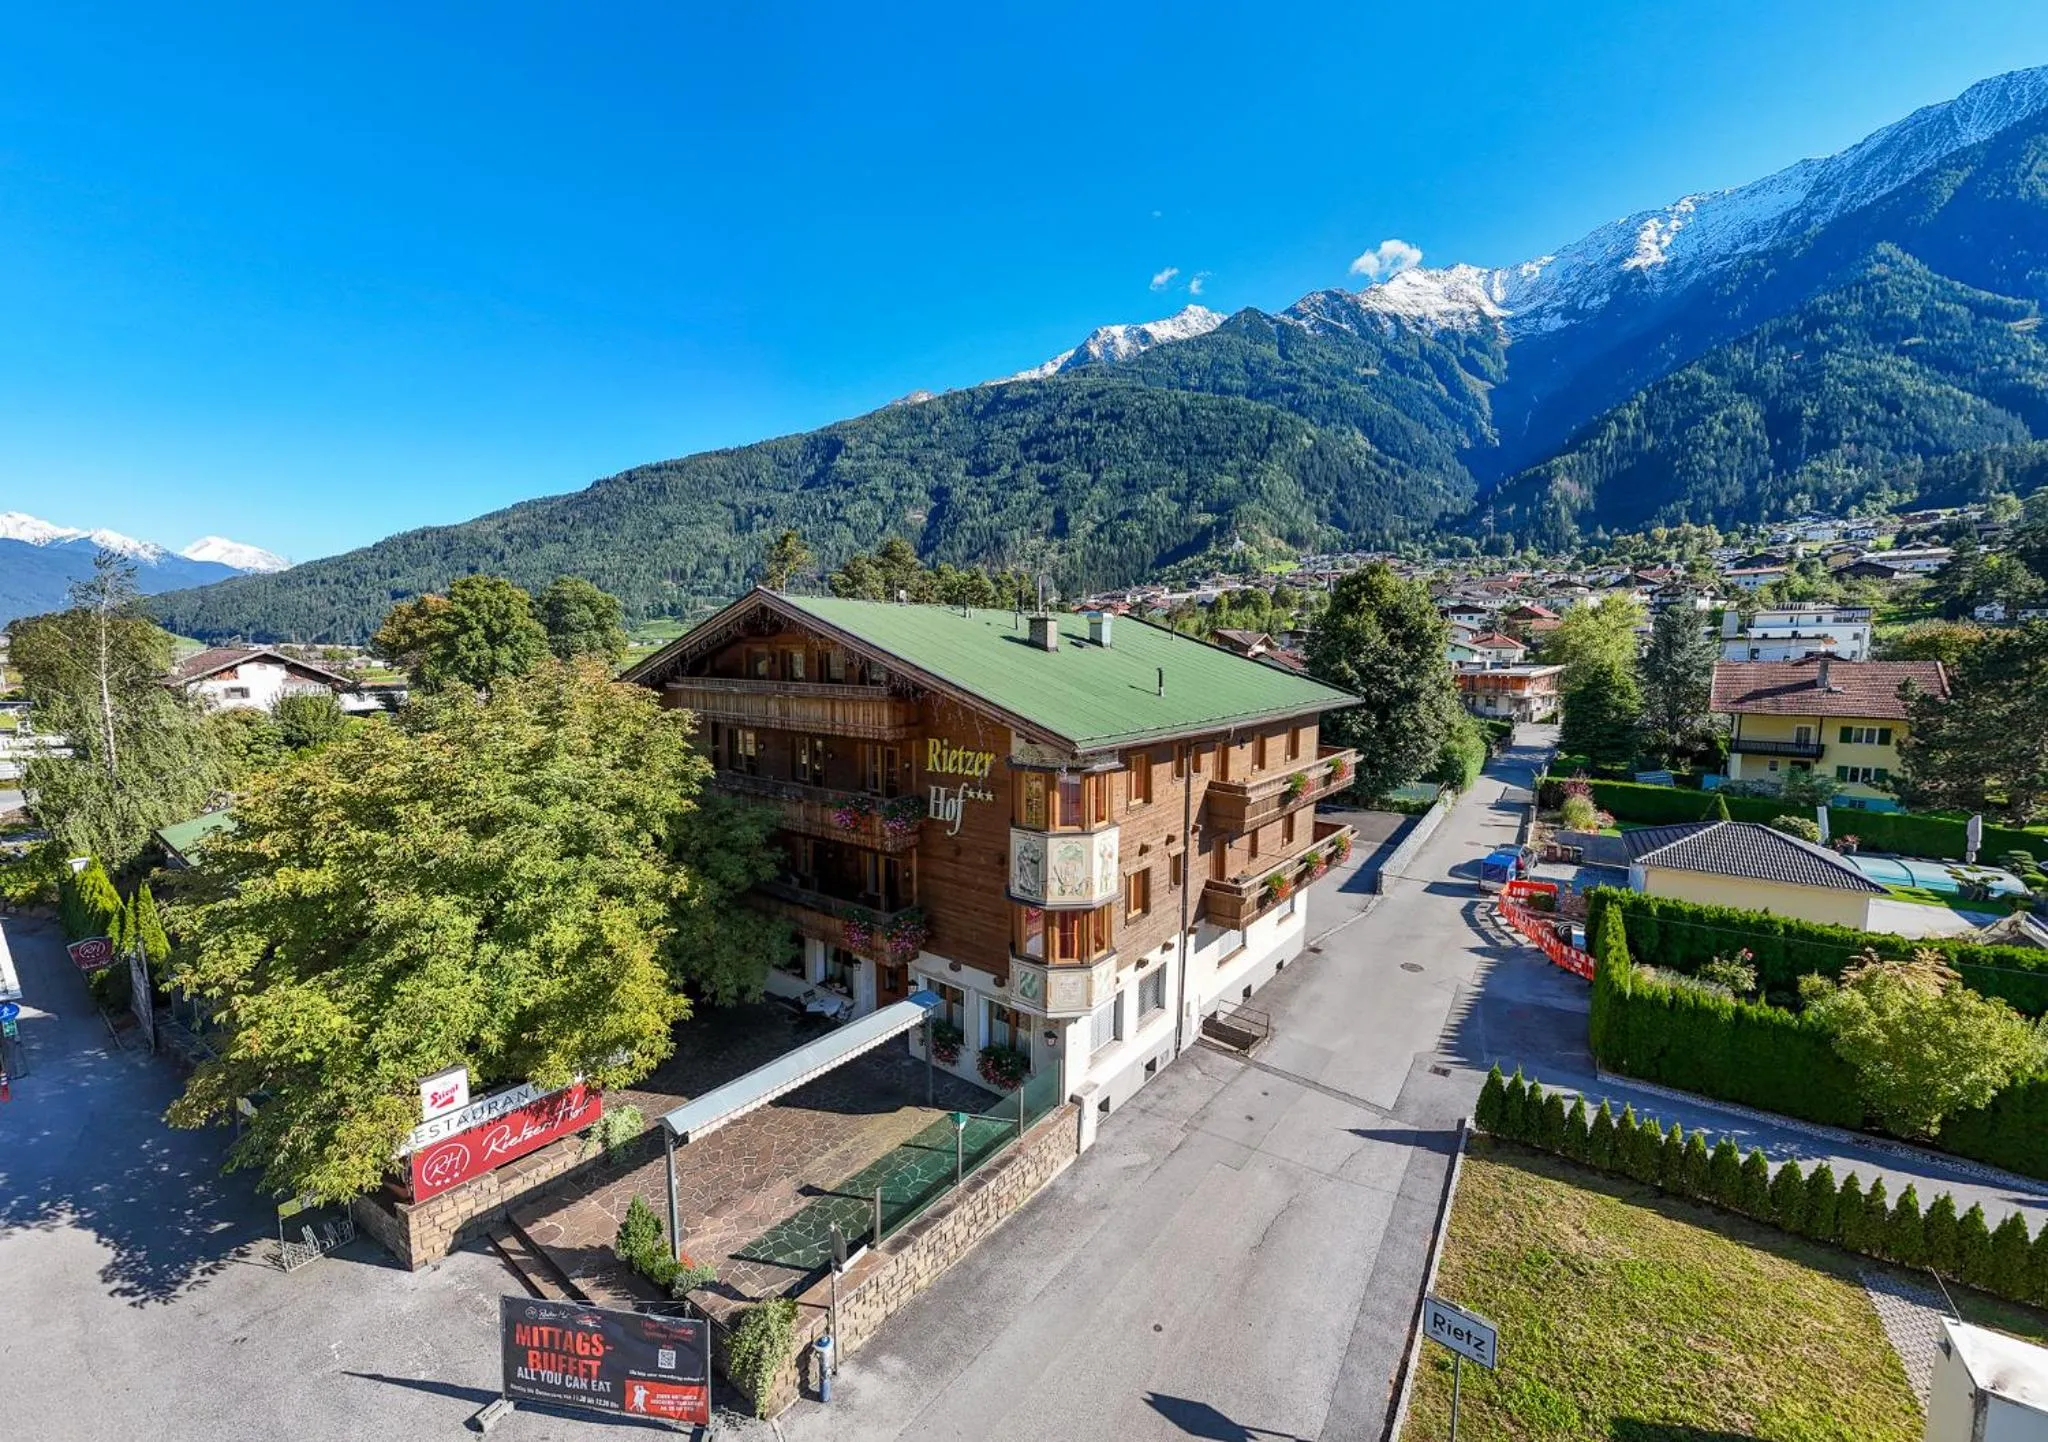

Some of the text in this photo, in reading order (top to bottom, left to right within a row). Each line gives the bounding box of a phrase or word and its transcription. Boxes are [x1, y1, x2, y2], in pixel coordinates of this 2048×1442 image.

[925, 738, 996, 777] Rietzer
[928, 782, 968, 836] Hof
[413, 1086, 539, 1144] ESTAURAN
[428, 1149, 463, 1180] RH
[515, 1320, 614, 1357] MITTAGS-
[1433, 1311, 1487, 1353] Rietz
[516, 1366, 611, 1393] ALL YOU CAN EAT
[527, 1349, 602, 1380] BUFFET
